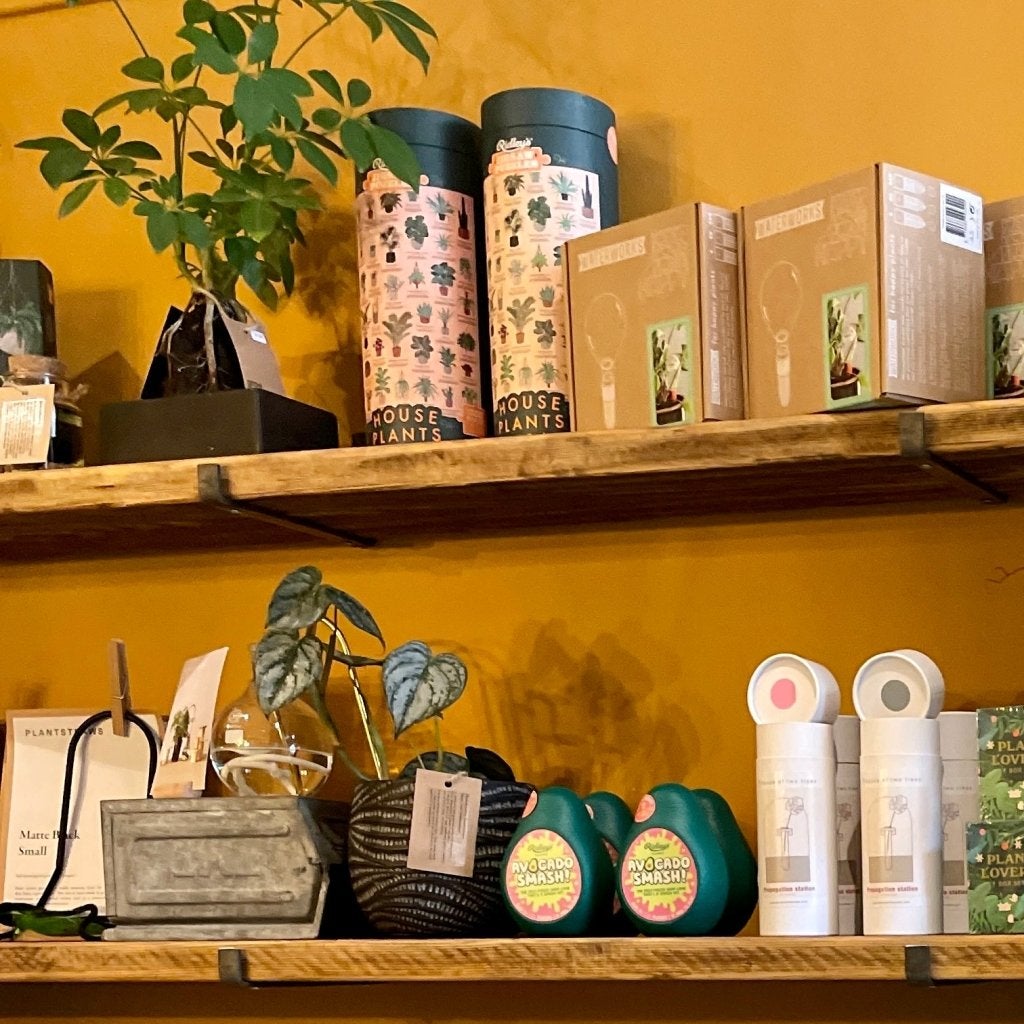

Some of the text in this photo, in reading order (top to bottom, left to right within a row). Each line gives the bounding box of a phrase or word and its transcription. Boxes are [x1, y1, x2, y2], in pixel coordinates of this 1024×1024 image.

[499, 395, 561, 416] HOUSE
[373, 408, 438, 428] HOUSE
[499, 414, 565, 434] PLANTS
[372, 427, 442, 446] PLANTS
[25, 727, 104, 737] PLANTSTWS
[19, 830, 50, 840] Matte
[18, 846, 47, 856] Small
[511, 857, 575, 874] AVOCADO
[628, 856, 691, 873] AVOCADO
[517, 868, 571, 888] SMASH!
[633, 869, 687, 886] SMASH!
